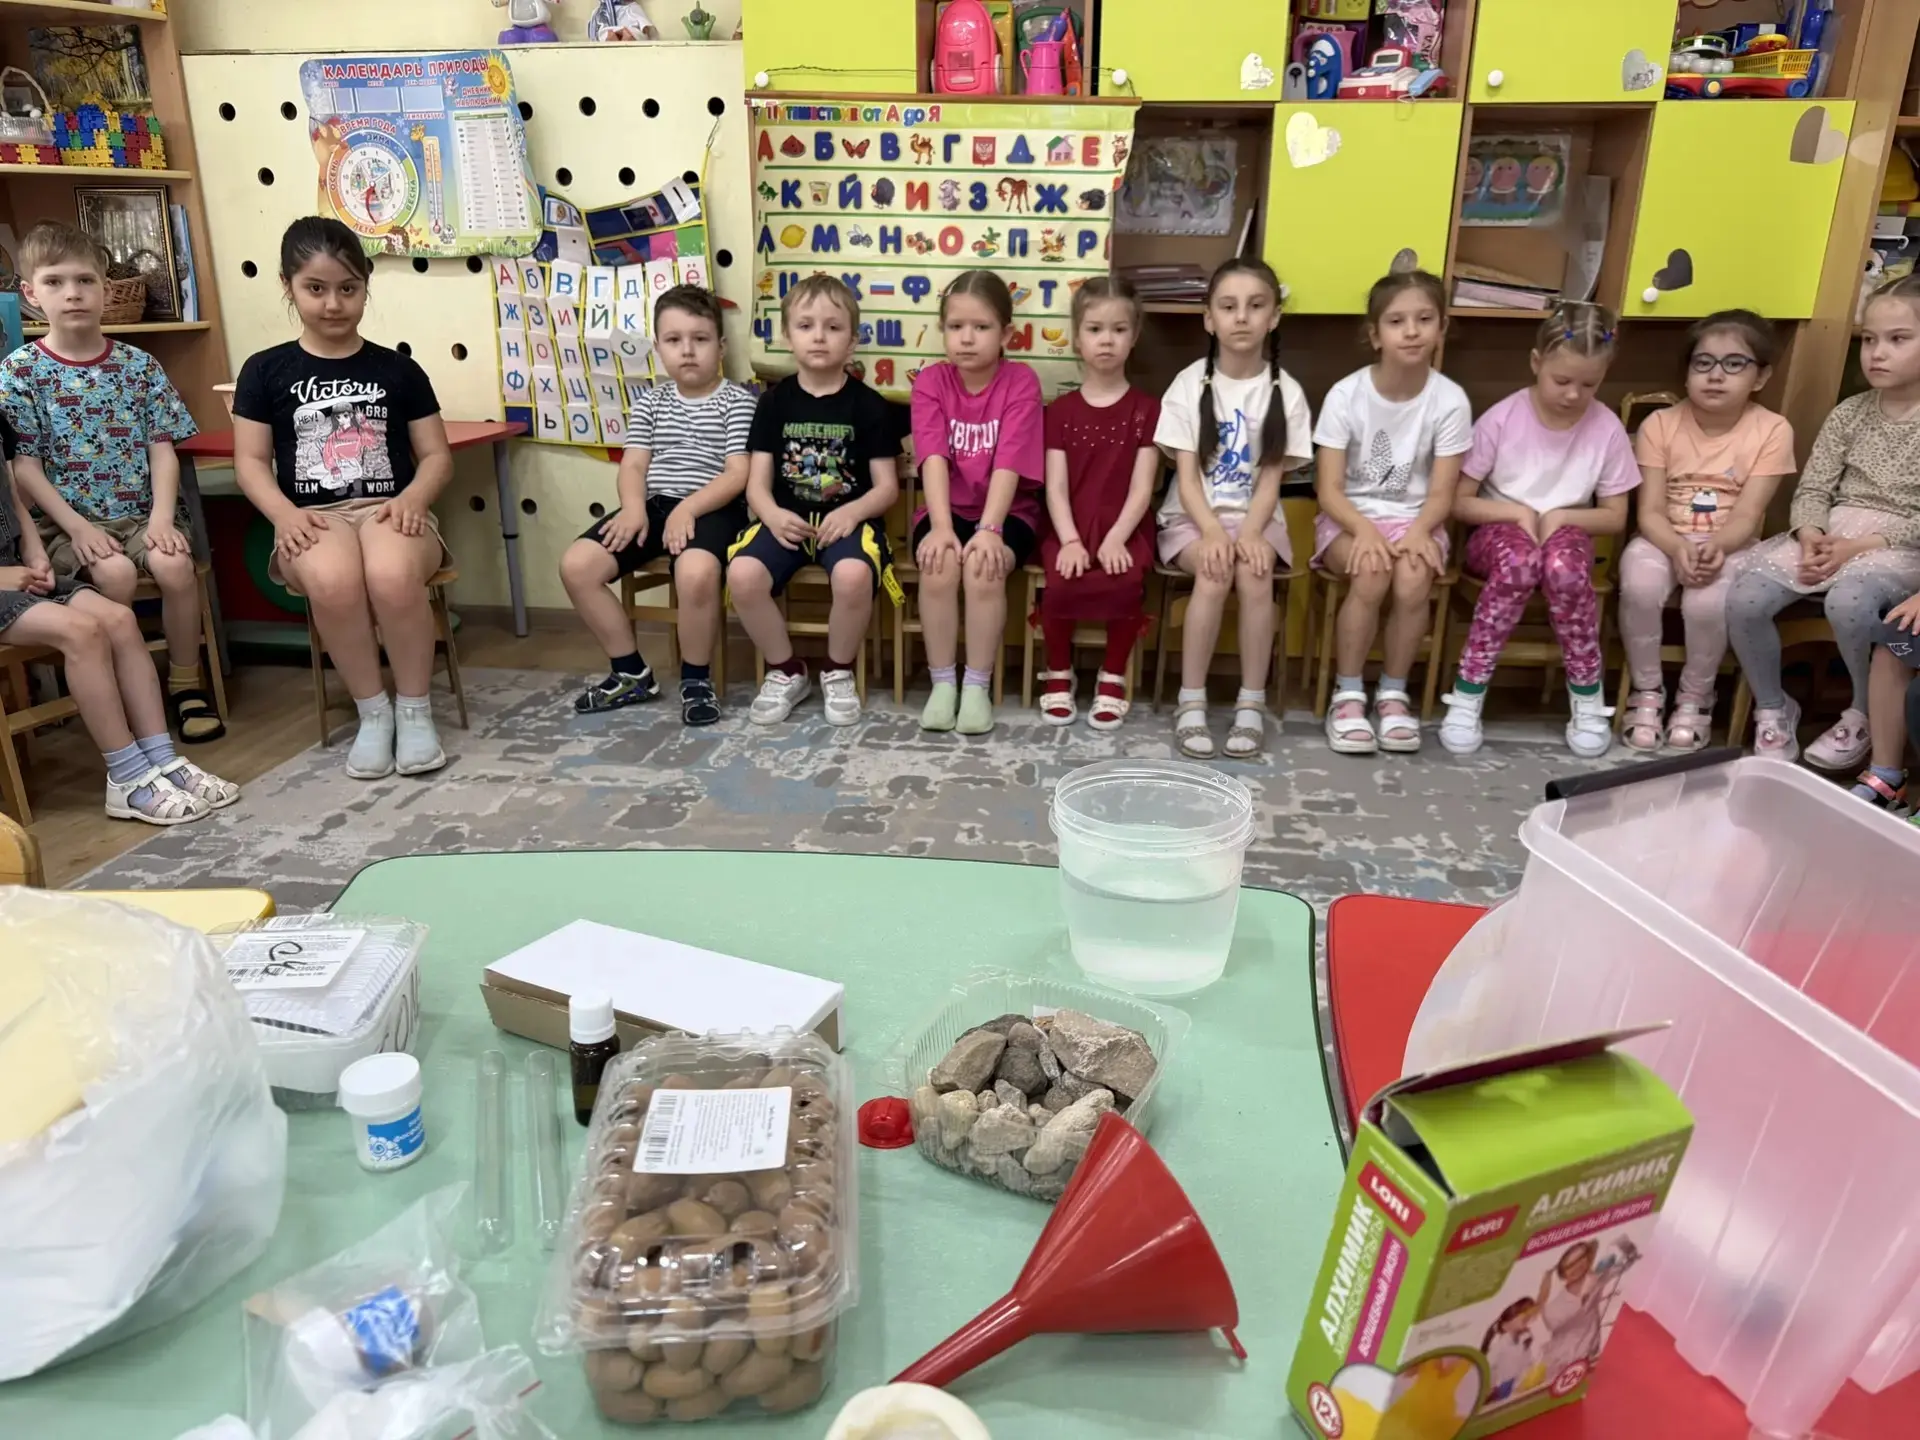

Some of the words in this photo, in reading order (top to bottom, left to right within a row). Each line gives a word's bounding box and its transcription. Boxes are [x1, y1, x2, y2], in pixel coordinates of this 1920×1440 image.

[323, 63, 424, 80] КАЛЕНДАРЬ
[428, 57, 489, 77] ПРИРОДЫ
[340, 118, 370, 135] ВРЕМЯ
[371, 118, 396, 135] ГОДА
[886, 104, 900, 122] А
[928, 104, 941, 122] Я
[367, 134, 391, 145] ЗИМА
[757, 130, 775, 162] А
[814, 131, 835, 162] Б
[880, 132, 900, 162] В
[943, 134, 961, 163] Г
[1006, 134, 1035, 164] Д
[1082, 136, 1101, 167] Е
[330, 160, 339, 191] ОСЕНЬ
[406, 180, 417, 211] ВЕСНА
[781, 179, 802, 210] К
[839, 173, 863, 210] Й
[905, 181, 929, 211] И
[969, 182, 988, 211] З
[1034, 183, 1068, 213] Ж
[354, 223, 376, 234] ЛЕТО
[757, 224, 776, 254] Л
[811, 224, 841, 253] М
[879, 225, 902, 254] Н
[938, 226, 963, 256] О
[1008, 228, 1028, 258] П
[1077, 229, 1097, 258] Р
[500, 263, 515, 285] А
[556, 272, 573, 295] В
[902, 275, 931, 304] Ф
[1038, 279, 1058, 308] Т
[754, 318, 773, 345] Ч
[874, 358, 895, 386] Я
[290, 376, 387, 404] Victory
[298, 411, 320, 426] HEY!
[365, 405, 388, 419] GR8
[295, 482, 319, 494] TEAM
[366, 481, 395, 493] WORK
[1370, 1175, 1411, 1223] LORI
[1528, 1153, 1676, 1219] АЛХИМИК
[1462, 1216, 1504, 1242] LORI
[1319, 1193, 1374, 1347] АЛХИМИК
